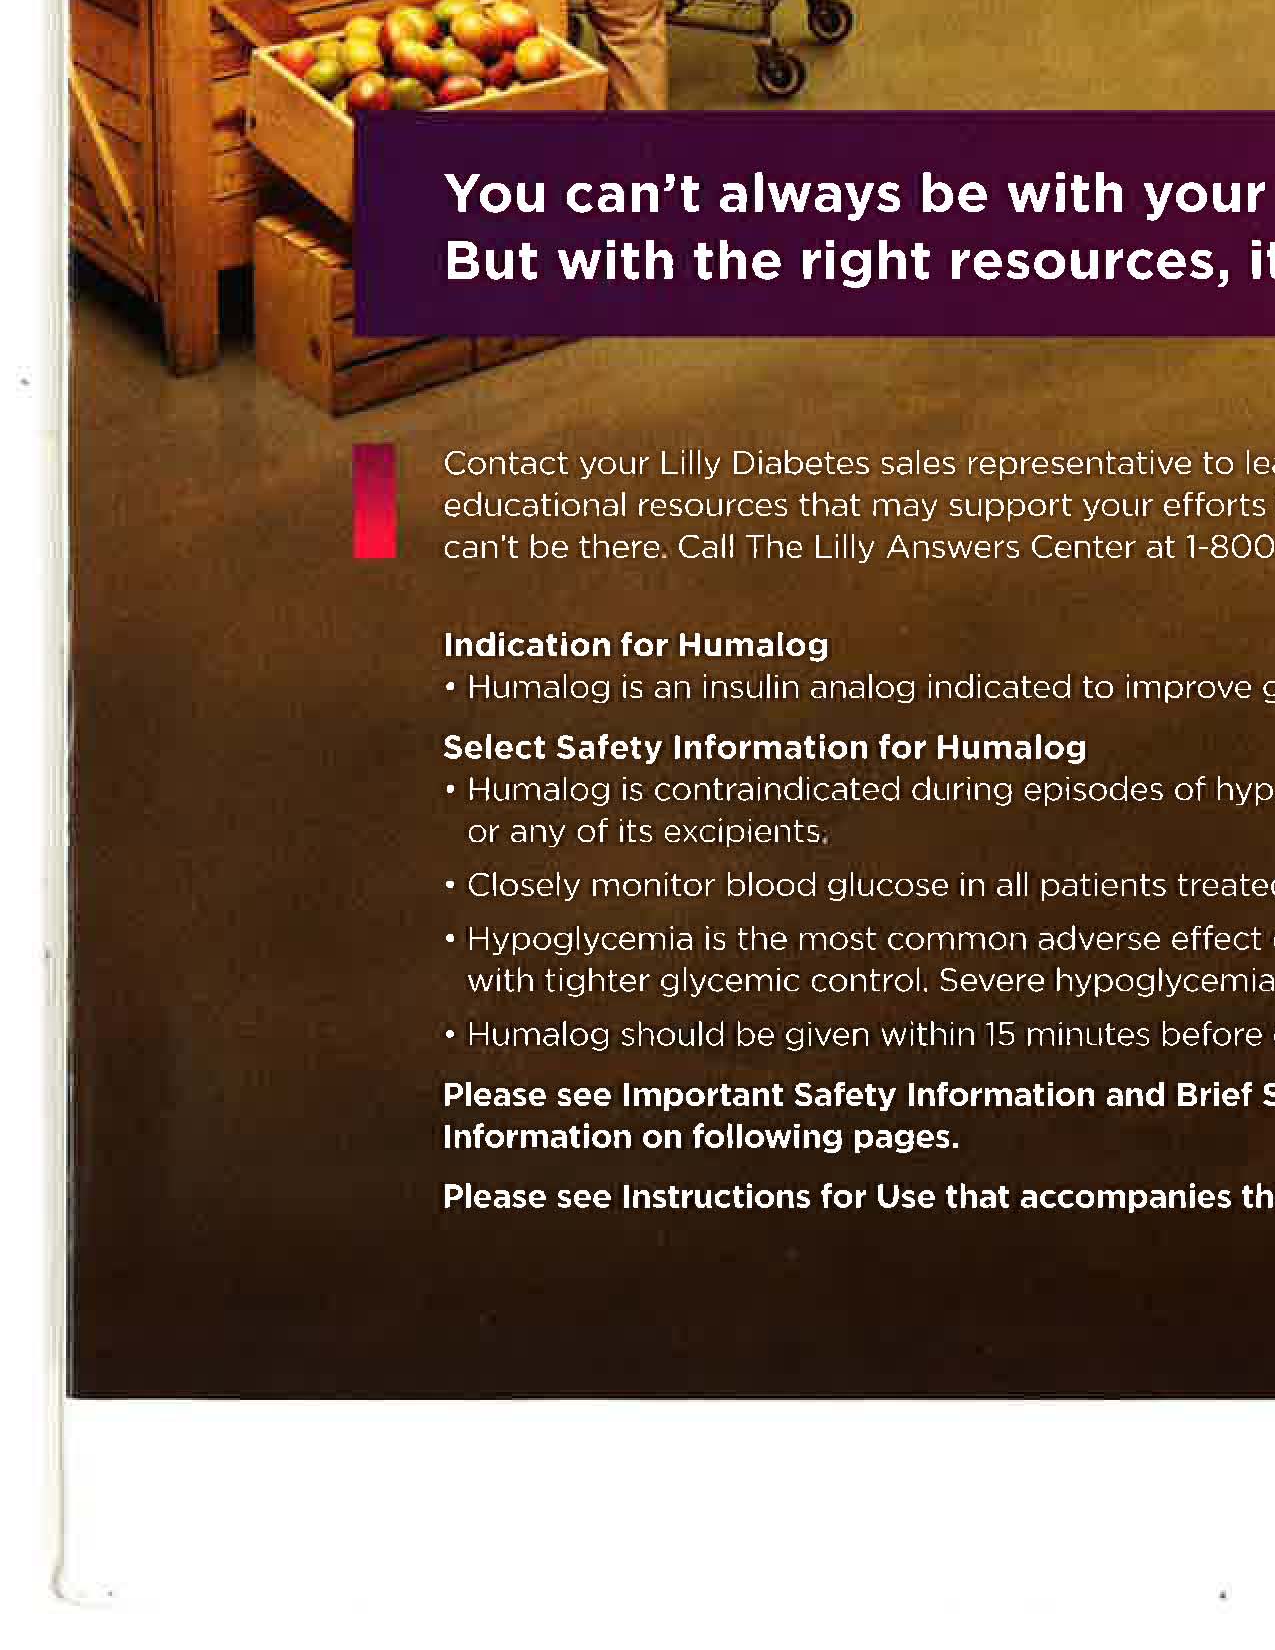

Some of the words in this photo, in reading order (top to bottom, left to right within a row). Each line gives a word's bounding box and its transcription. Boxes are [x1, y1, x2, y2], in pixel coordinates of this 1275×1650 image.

[443, 173, 545, 214] You
[566, 173, 700, 214] can't
[719, 171, 901, 222] always
[922, 171, 988, 213] be
[1007, 171, 1123, 213] with
[1143, 181, 1266, 222] your
[447, 240, 538, 281] But
[557, 239, 674, 281] with
[693, 239, 782, 281] the
[802, 239, 931, 289] right
[951, 248, 1229, 288] resources,
[444, 450, 569, 476] Contact
[579, 456, 650, 480] your
[661, 449, 721, 480] Lilly
[733, 449, 870, 476] Diabetes
[881, 449, 956, 476] sales
[968, 449, 1192, 481] representative
[1202, 451, 1234, 475] to
[444, 534, 519, 559] can't
[530, 533, 569, 559] be
[578, 533, 667, 559] there.
[678, 533, 734, 559] Call
[745, 533, 803, 559] The
[815, 533, 875, 564] Lilly
[886, 534, 1020, 559] Answers
[1031, 534, 1137, 559] Center
[1146, 535, 1176, 559] at
[445, 631, 611, 657] Indication
[620, 631, 669, 657] for
[679, 631, 828, 663] Humalog
[469, 673, 610, 704] Humalog
[622, 673, 643, 699] is
[654, 680, 691, 699] an
[703, 673, 799, 699] insulin
[810, 673, 915, 704] analog
[928, 673, 1071, 699] indicated
[1082, 675, 1114, 699] to
[1126, 673, 1252, 704] improve
[443, 733, 546, 760] Select
[556, 733, 663, 765] Safety
[674, 733, 868, 760] Information
[878, 733, 927, 760] for
[937, 733, 1086, 765] Humalog
[468, 824, 500, 843] or
[510, 824, 566, 848] any
[577, 817, 609, 843] of
[619, 819, 653, 843] its
[664, 817, 827, 848] excipients.
[468, 871, 581, 902] Closely
[592, 871, 716, 897] monitor
[727, 871, 816, 897] blood
[827, 871, 949, 902] glucose
[960, 871, 985, 897] in
[996, 871, 1028, 897] all
[1041, 873, 1167, 902] patients
[469, 925, 693, 956] Hypoglycemia
[705, 925, 726, 951] is
[737, 925, 788, 951] the
[799, 926, 877, 951] most
[887, 931, 1027, 951] common
[1038, 924, 1161, 951] adverse
[1171, 924, 1262, 951] effect
[444, 1081, 547, 1107] Please
[557, 1087, 612, 1107] see
[623, 1082, 784, 1112] Important
[794, 1081, 897, 1112] Safety
[908, 1081, 1095, 1107] Information
[1106, 1081, 1165, 1107] and
[1177, 1081, 1253, 1107] Brief
[444, 1122, 632, 1149] Information
[642, 1129, 682, 1149] on
[692, 1122, 843, 1154] following
[854, 1129, 959, 1154] pages.
[444, 1182, 547, 1209] Please
[557, 1189, 612, 1209] see
[623, 1182, 811, 1209] Instructions
[820, 1182, 867, 1209] for
[877, 1183, 936, 1209] Use
[945, 1182, 1010, 1209] that
[1020, 1182, 1232, 1214] accompanies
